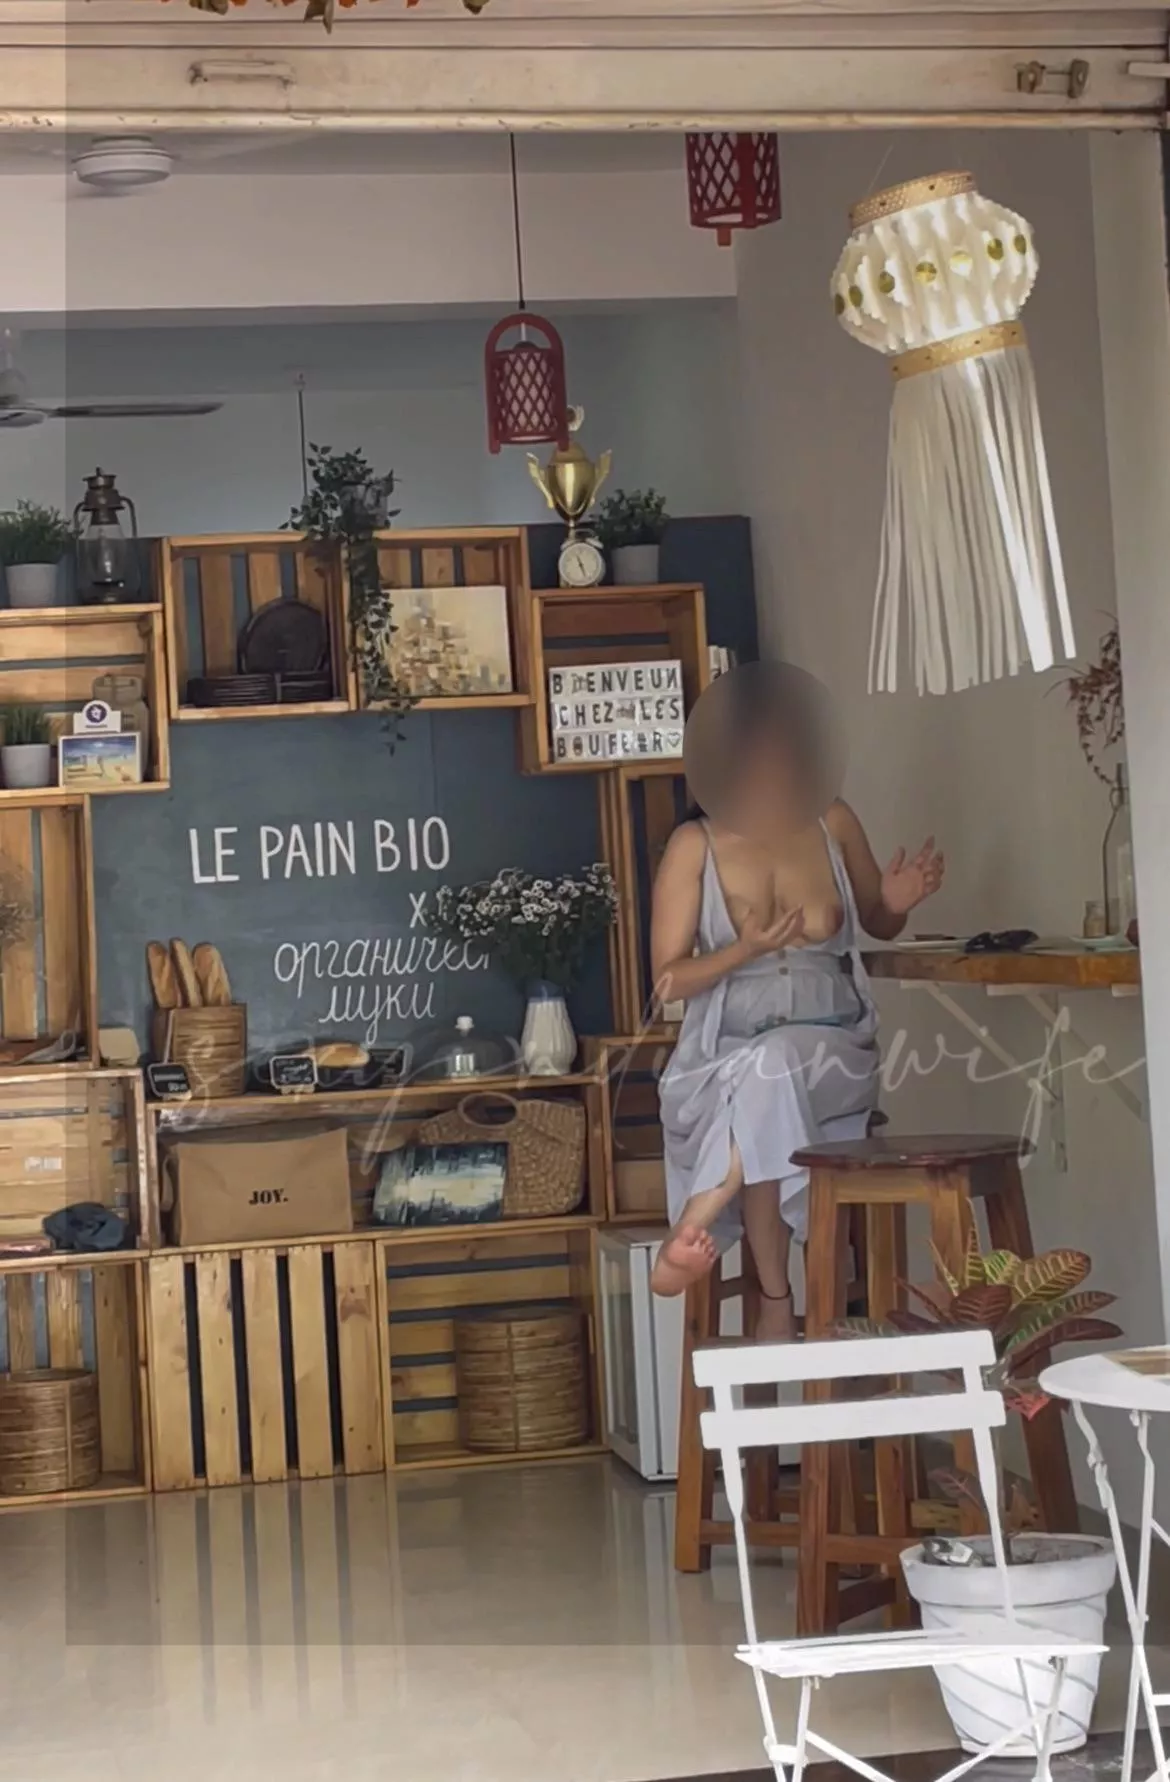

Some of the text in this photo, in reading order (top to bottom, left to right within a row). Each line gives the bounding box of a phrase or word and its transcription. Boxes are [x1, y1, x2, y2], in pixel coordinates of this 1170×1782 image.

[558, 697, 680, 727] CHEZ LES
[188, 816, 451, 884] LE PAIN BIO
[248, 1187, 289, 1206] JOY.
